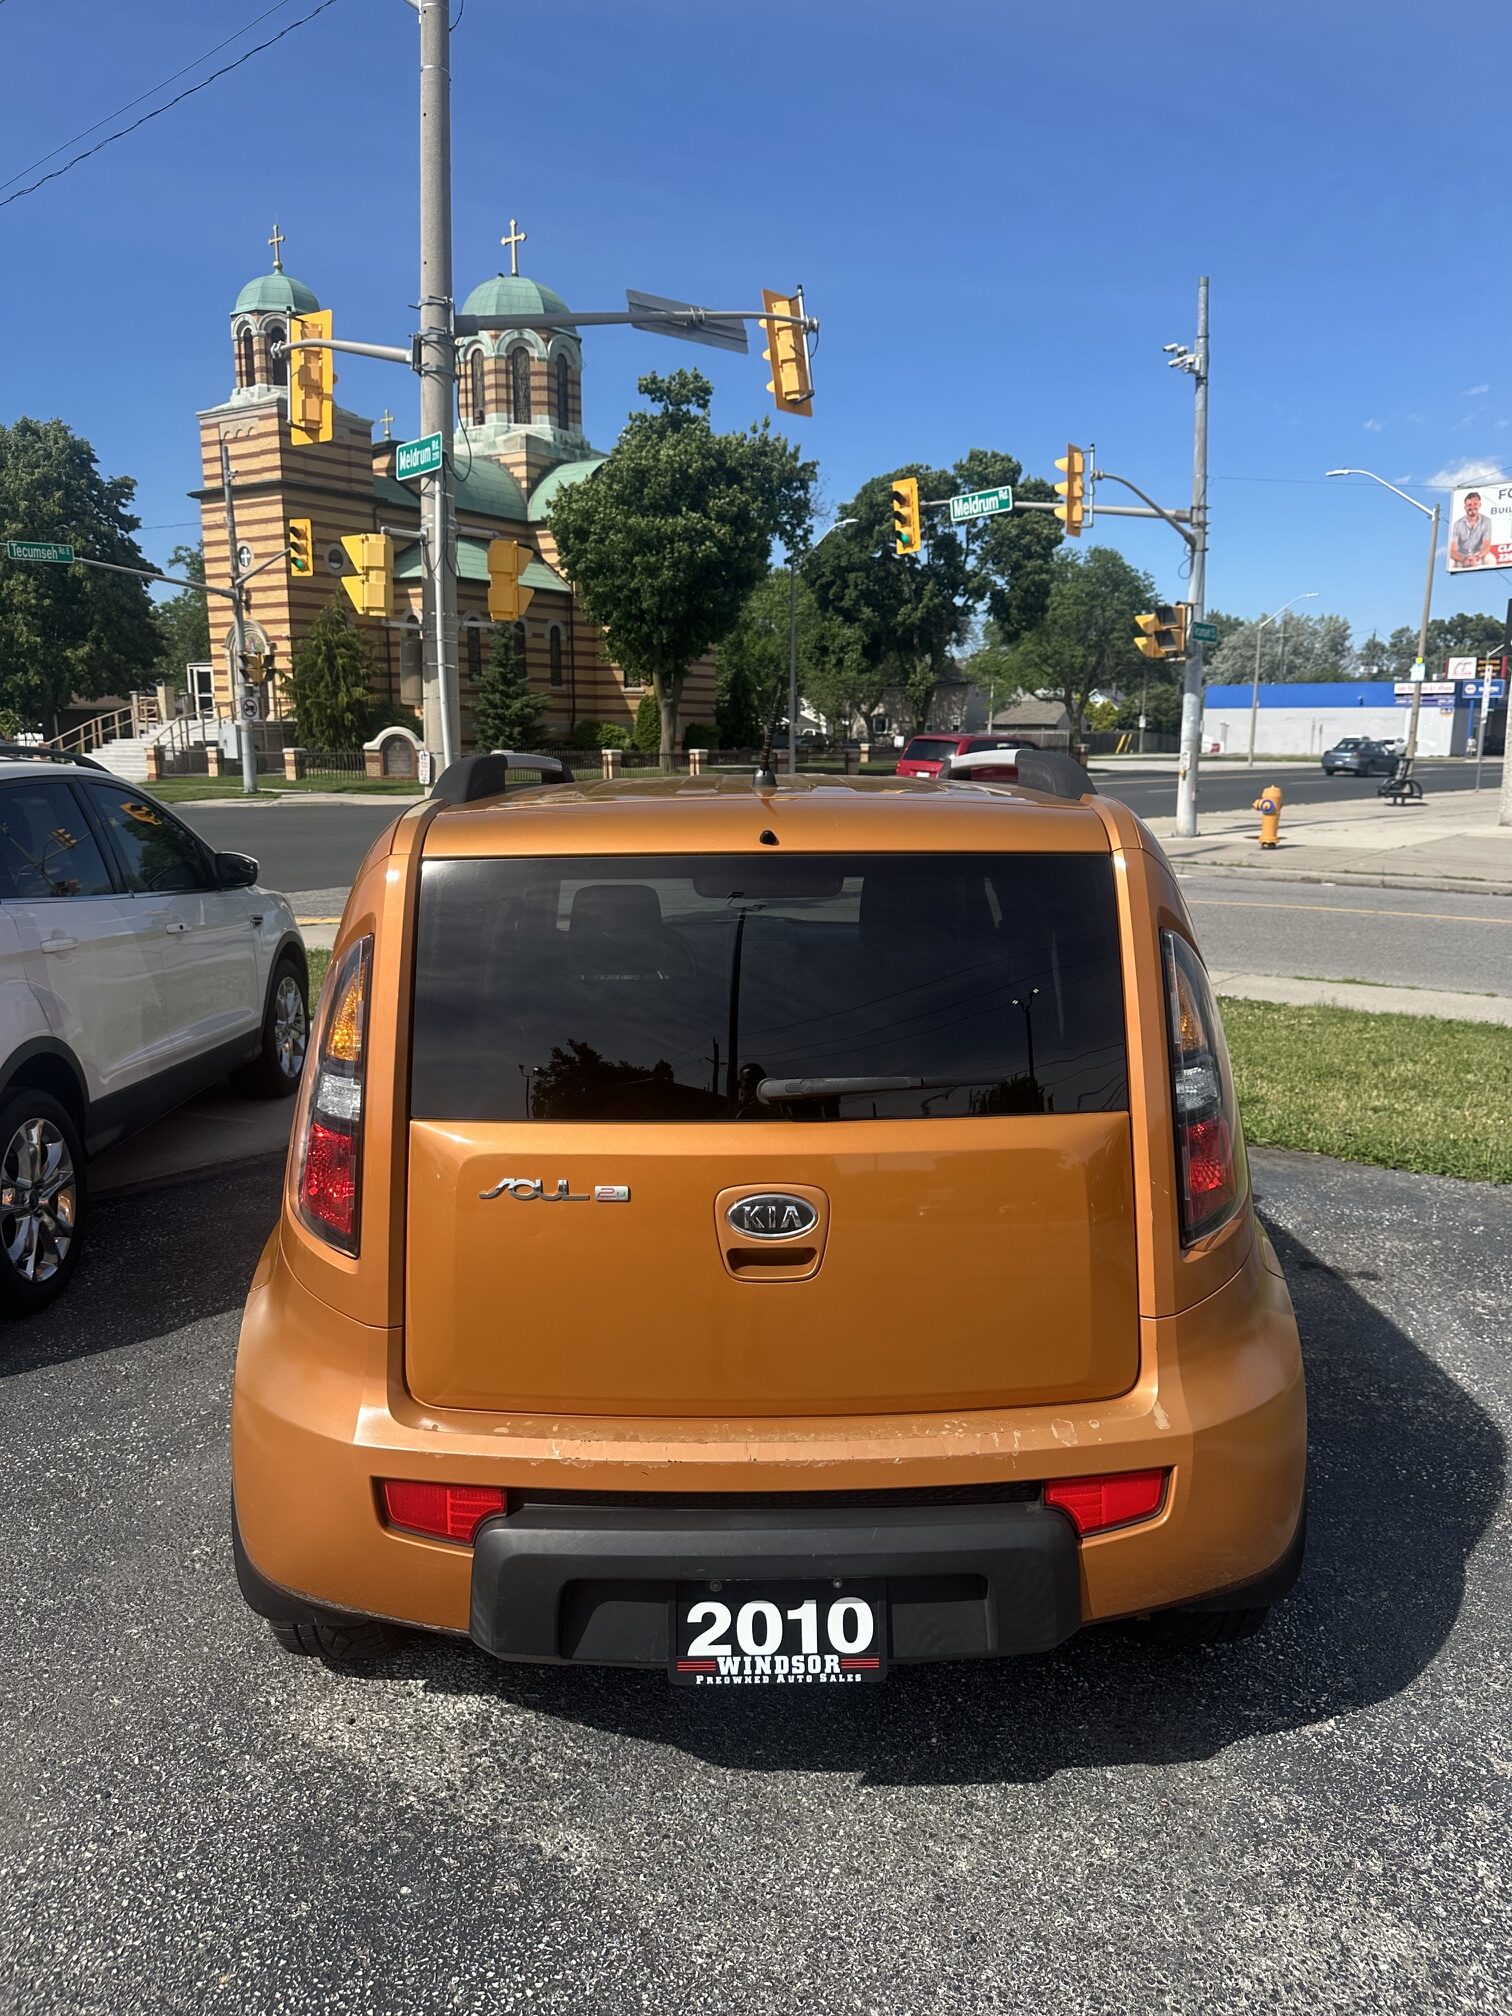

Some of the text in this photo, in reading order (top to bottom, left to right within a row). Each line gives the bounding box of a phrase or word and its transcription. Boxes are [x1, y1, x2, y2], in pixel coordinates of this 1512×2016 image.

[400, 447, 431, 470] Meldrum
[954, 496, 999, 517] Meldrum
[11, 543, 58, 559] Tecumseh
[743, 1205, 802, 1229] KIA
[686, 1596, 874, 1656] 2010
[717, 1654, 841, 1675] WINDSOR
[696, 1673, 862, 1684] PREOWNED AUTO SALES
